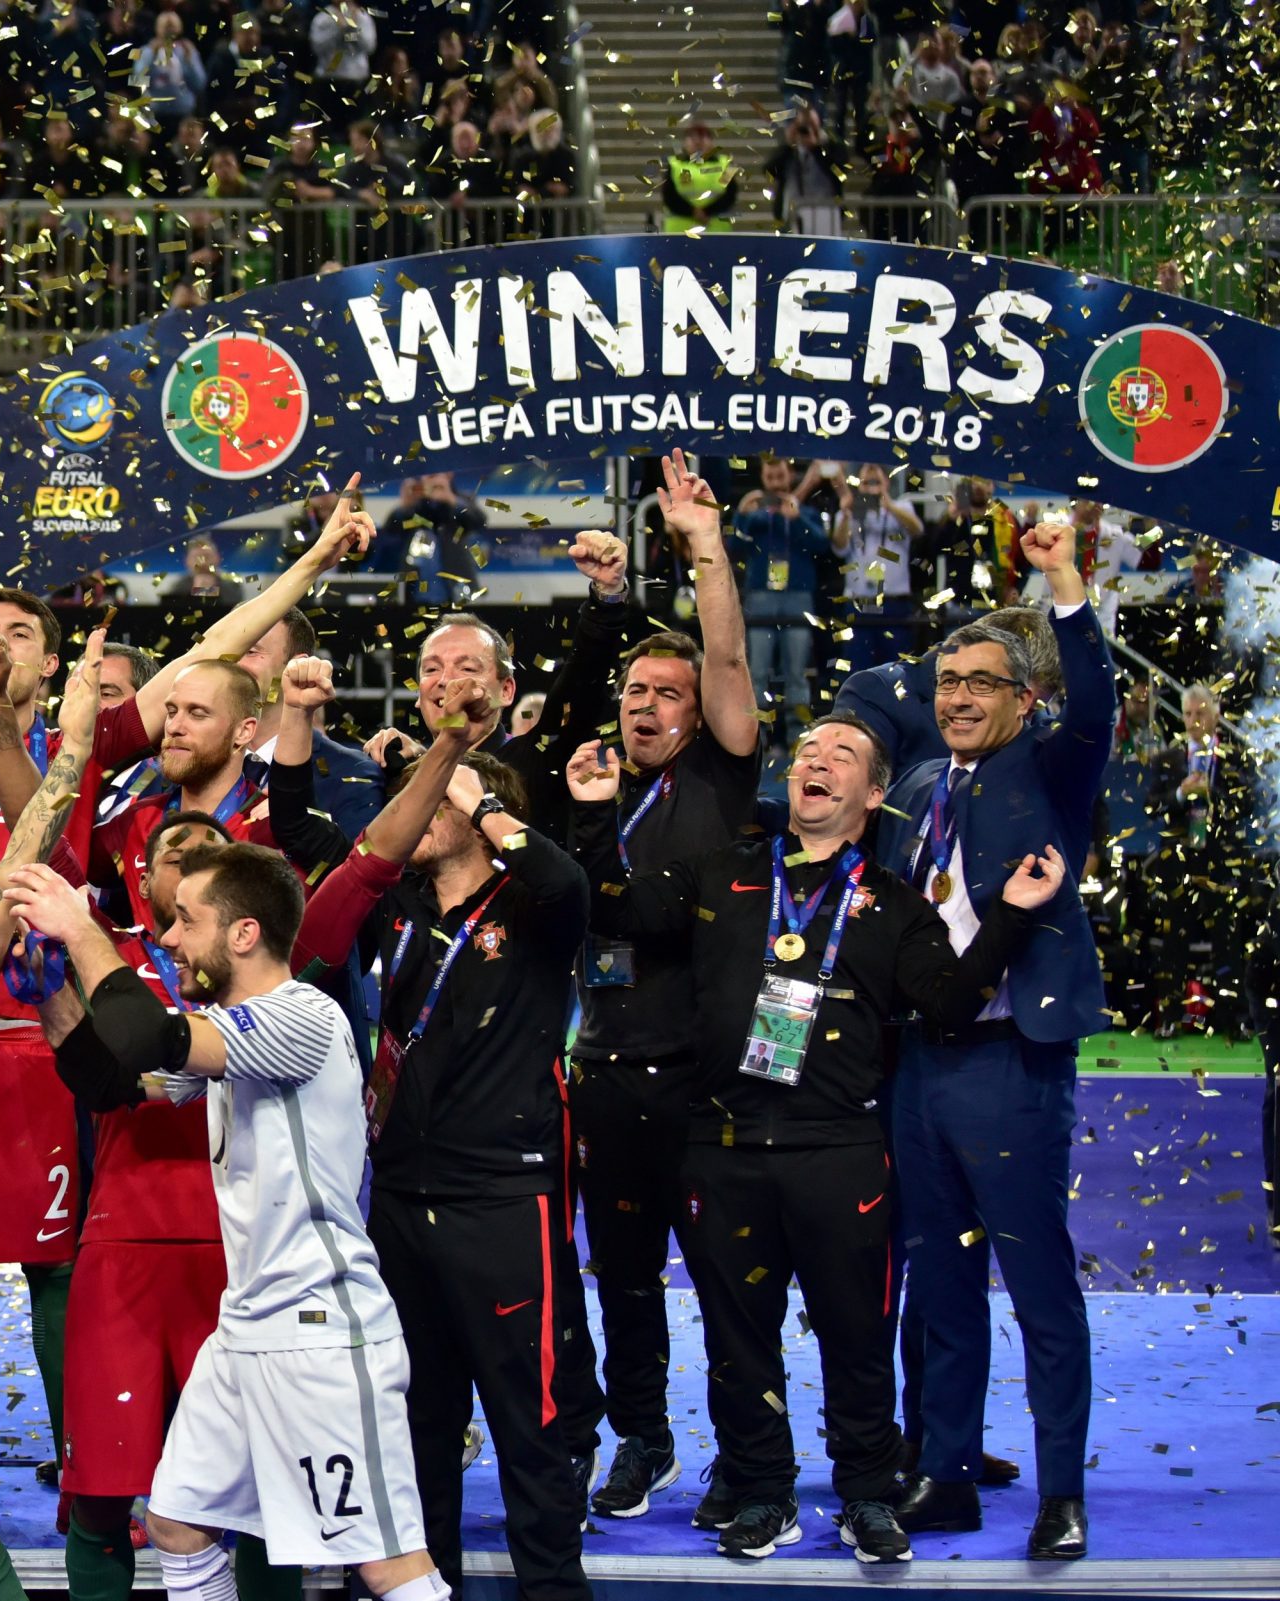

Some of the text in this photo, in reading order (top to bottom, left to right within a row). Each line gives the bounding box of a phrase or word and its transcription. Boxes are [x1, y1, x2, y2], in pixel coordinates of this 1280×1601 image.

[348, 265, 1053, 405] WINNERS
[418, 393, 982, 451] UEFA FUTSAL EURO 2018
[49, 471, 106, 485] FUTSAL
[33, 486, 120, 518] EURO
[622, 790, 656, 836] UEFA FUTSAL EURO
[834, 915, 844, 931] UEFA
[838, 899, 848, 916] FUTSAL
[396, 941, 406, 959] UEFA
[434, 938, 462, 990] UEFA FUTSAL EURO
[775, 1031, 797, 1045] 6 7
[782, 1019, 804, 1034] 3 4
[44, 1164, 70, 1219] 2
[299, 1453, 363, 1516] 12
